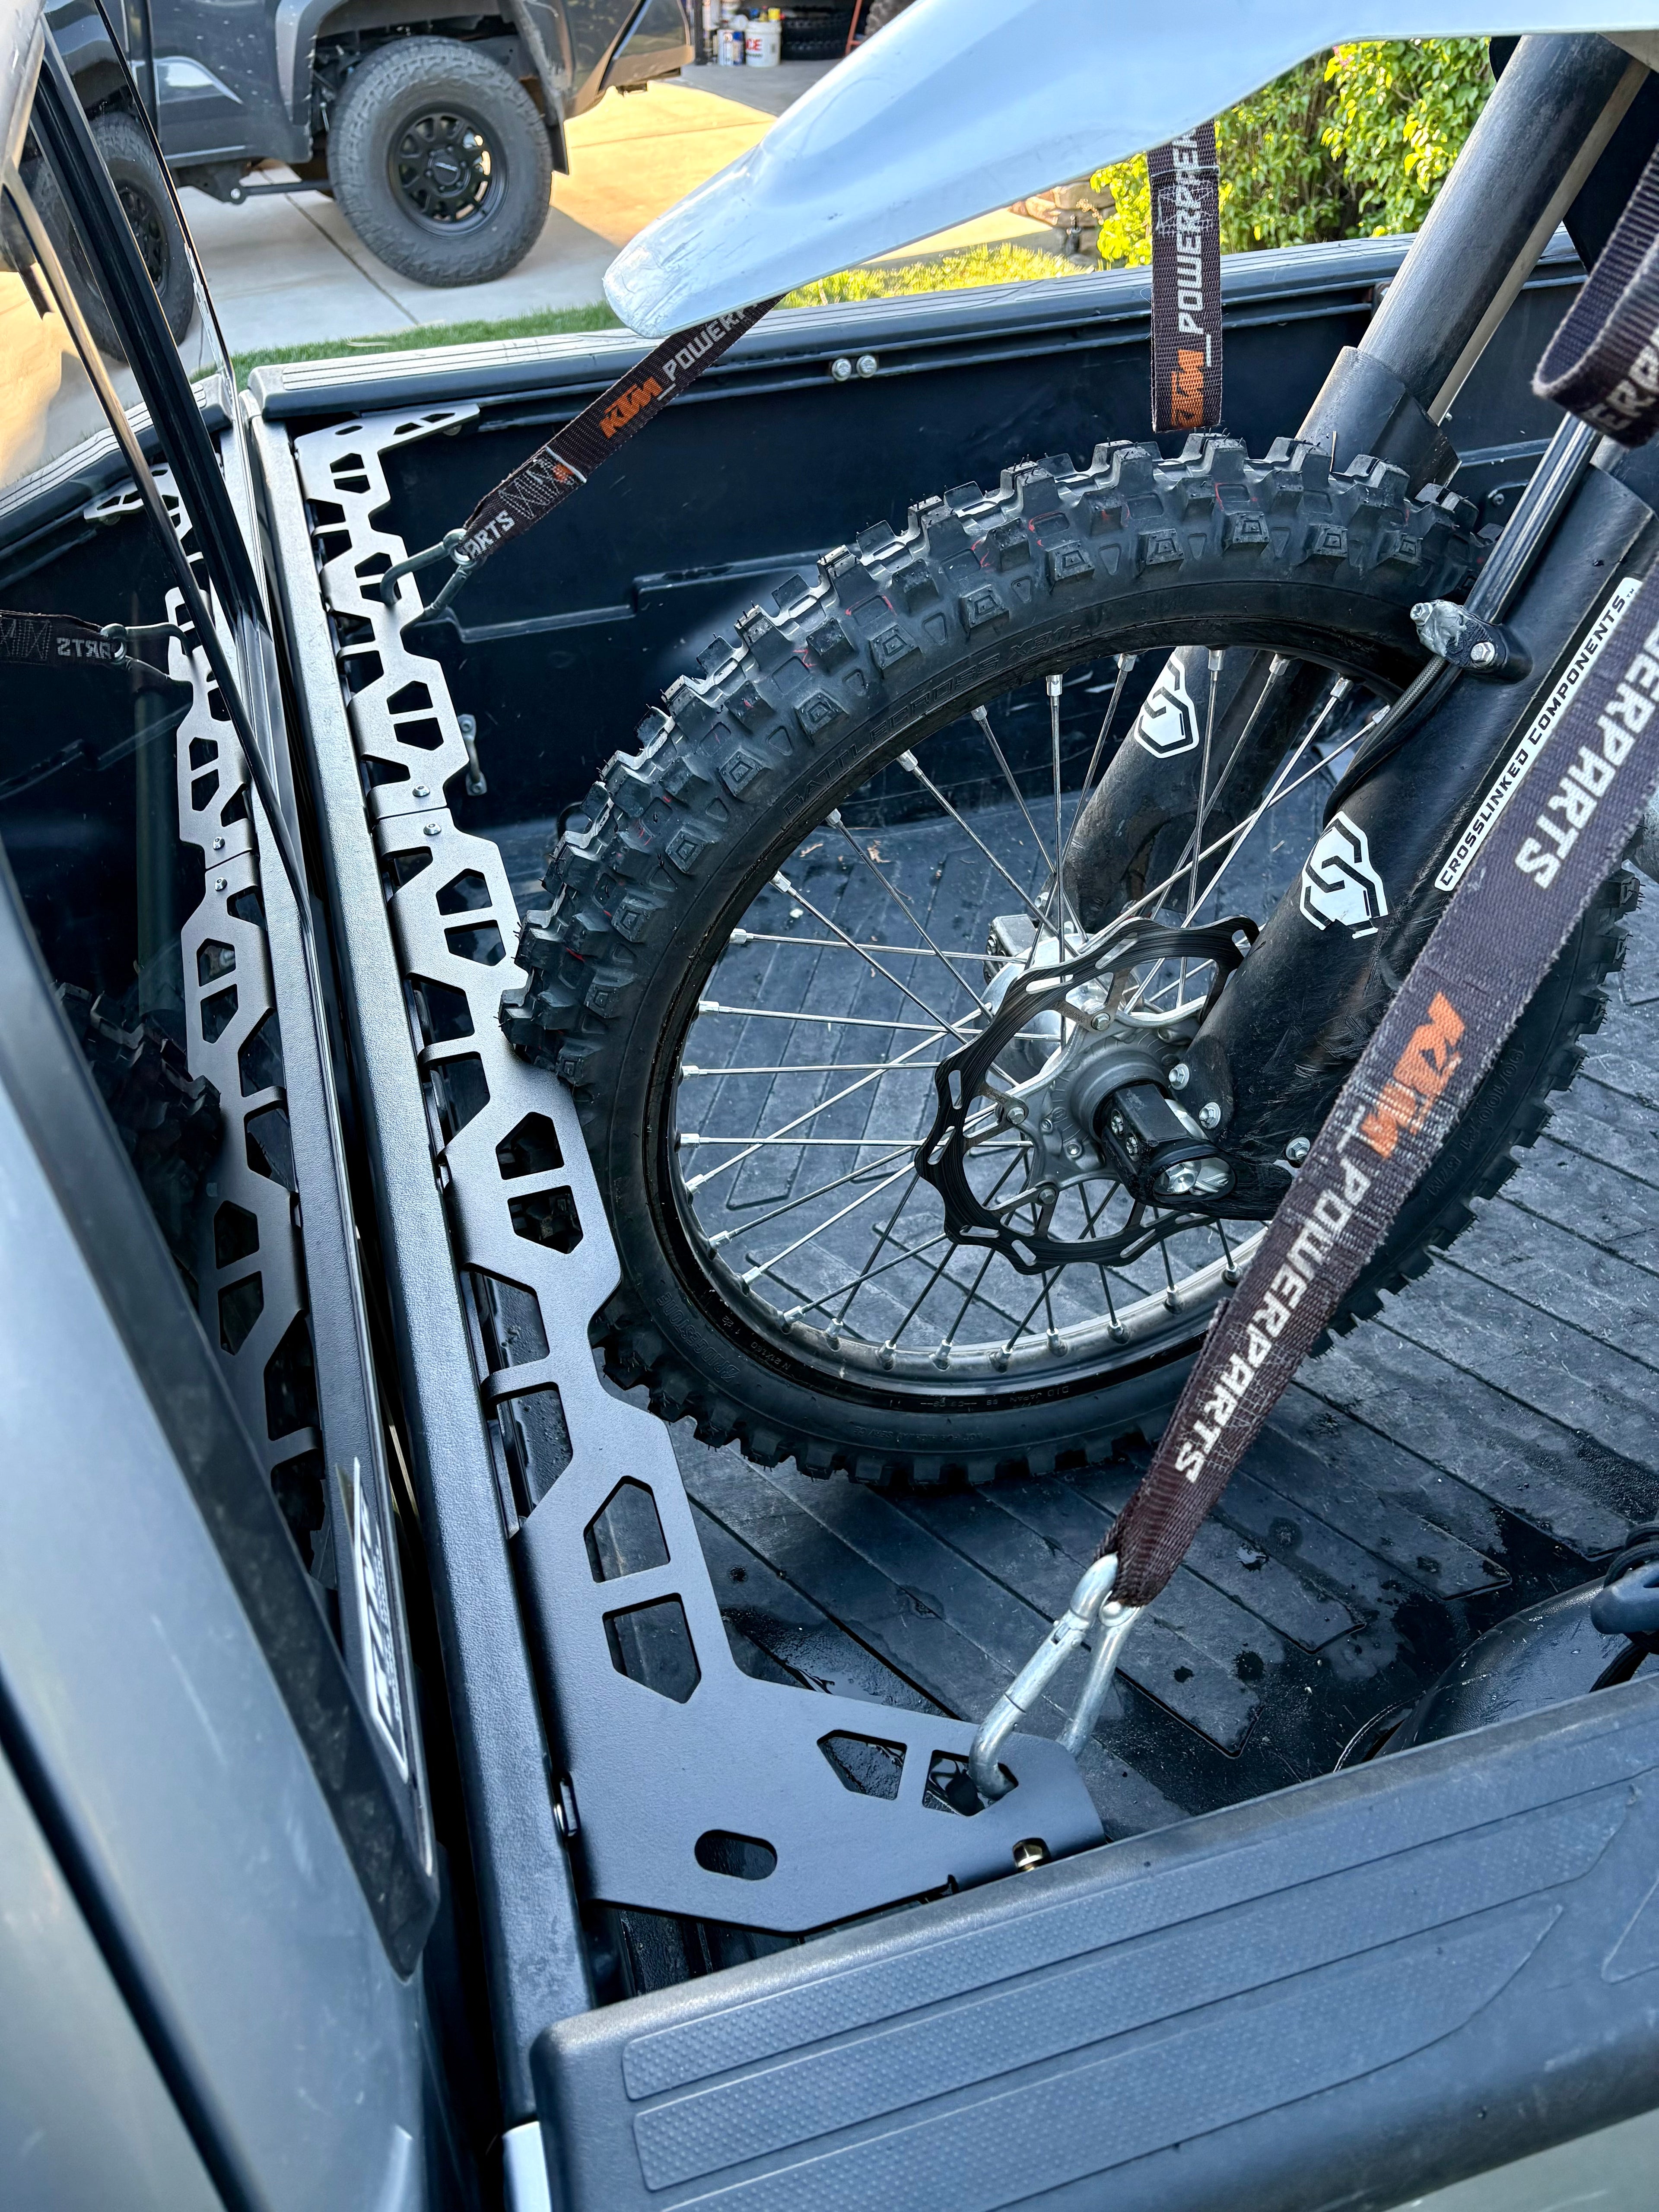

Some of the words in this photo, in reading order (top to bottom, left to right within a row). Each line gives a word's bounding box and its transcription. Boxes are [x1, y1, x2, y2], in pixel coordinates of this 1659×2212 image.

[745, 38, 761, 51] CE
[599, 376, 663, 439] KTM
[1440, 749, 1529, 887] CROSSLINKED
[657, 1291, 740, 1383] BRIDGESTONE
